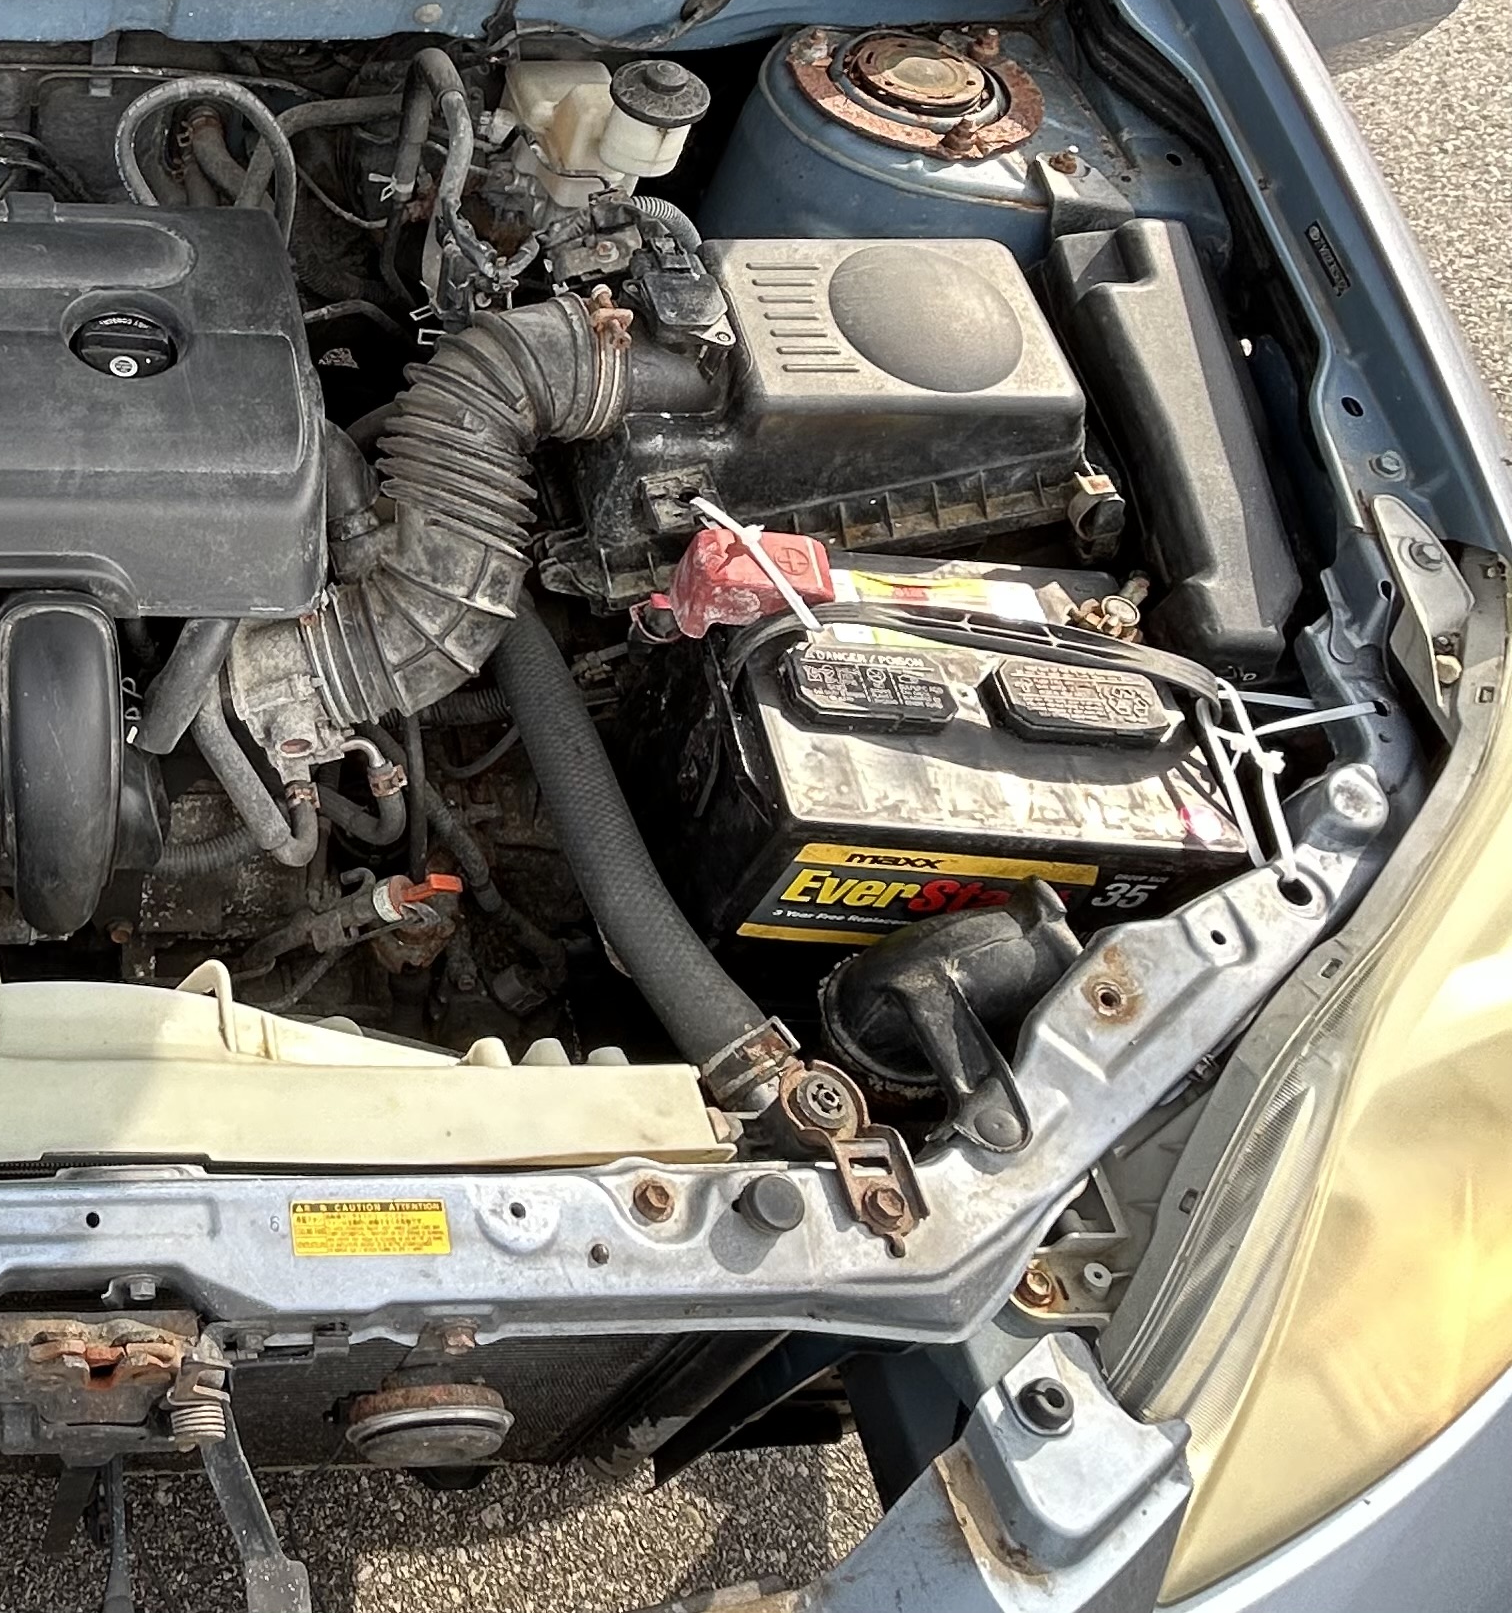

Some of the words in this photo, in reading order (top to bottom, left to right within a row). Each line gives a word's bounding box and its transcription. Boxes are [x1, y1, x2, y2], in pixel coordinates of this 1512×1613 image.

[817, 651, 867, 664] DANGER
[877, 655, 925, 668] POISON
[846, 853, 942, 869] maxx
[1091, 882, 1158, 909] 35
[334, 1203, 381, 1213] CAUTION
[388, 1201, 440, 1212] ATTENTION
